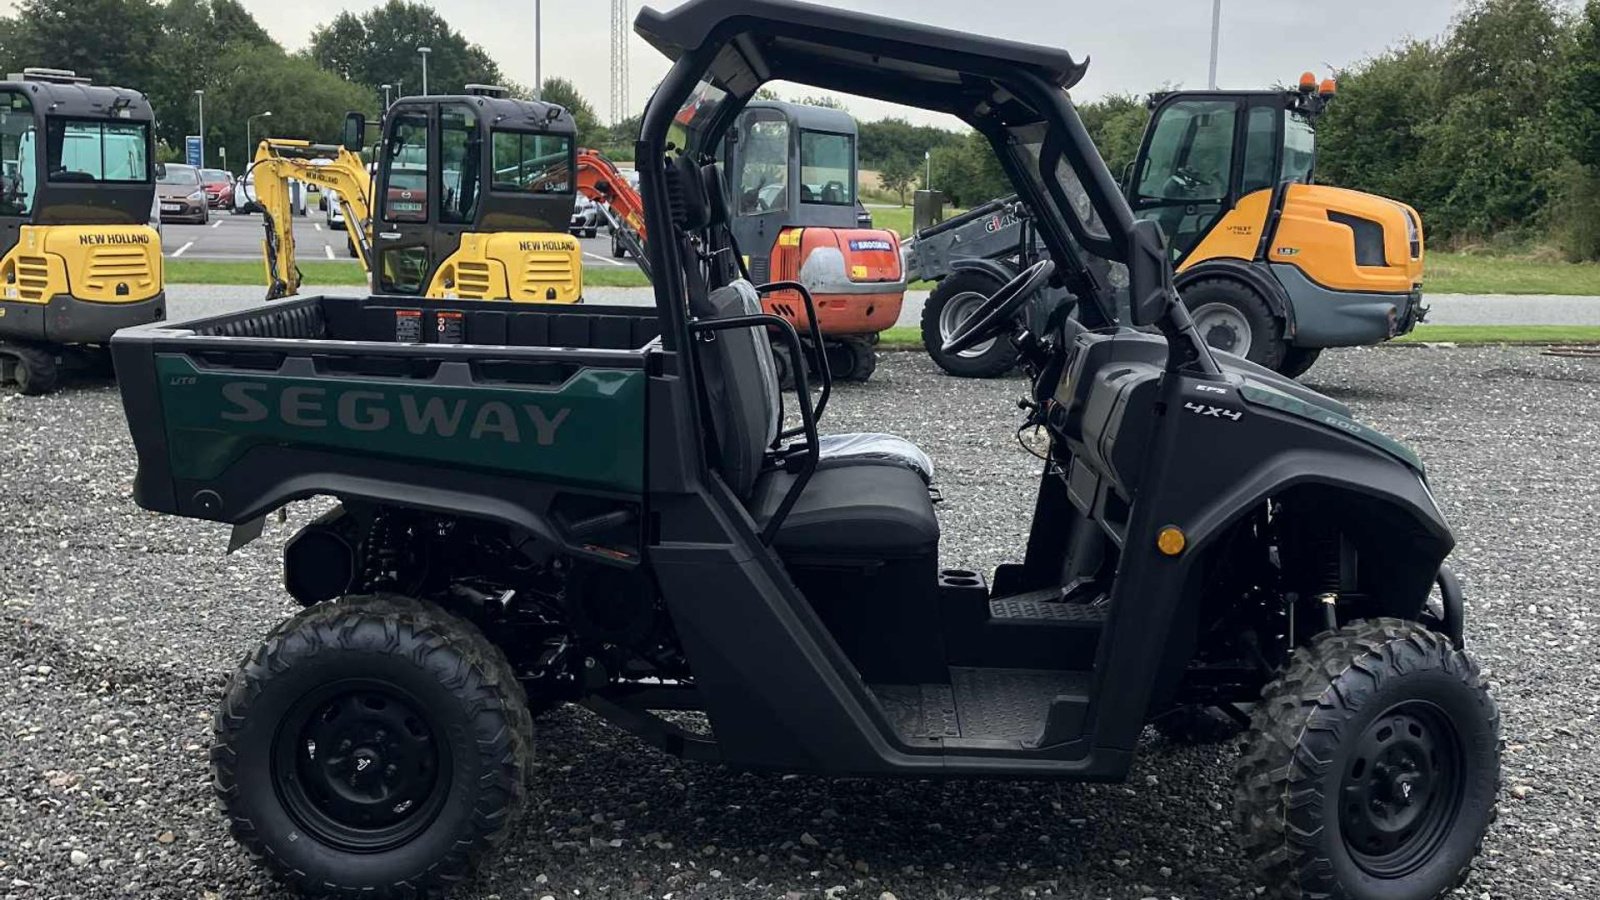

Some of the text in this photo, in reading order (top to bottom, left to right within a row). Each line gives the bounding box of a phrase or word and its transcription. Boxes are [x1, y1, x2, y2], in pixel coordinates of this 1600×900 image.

[79, 233, 150, 245] NEW HOLLAND
[519, 240, 575, 251] NEW HOLLAND
[1195, 384, 1227, 394] EPS
[220, 381, 571, 446] SEGWAY
